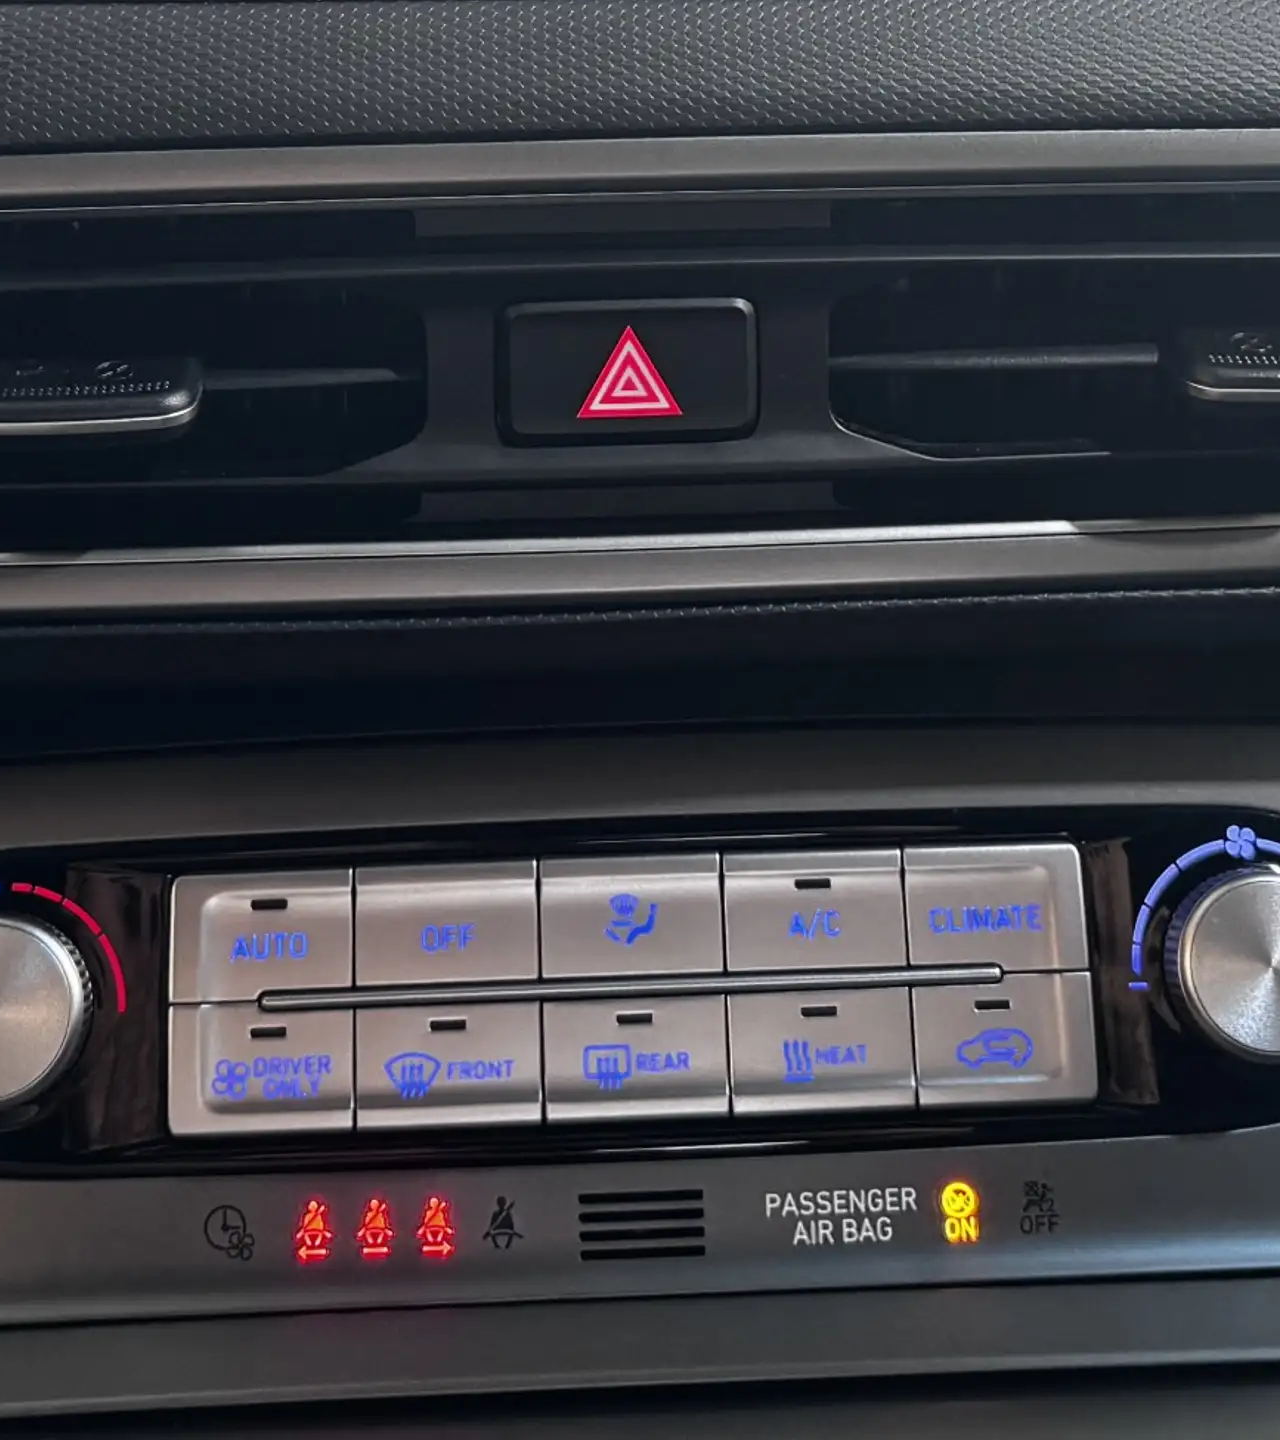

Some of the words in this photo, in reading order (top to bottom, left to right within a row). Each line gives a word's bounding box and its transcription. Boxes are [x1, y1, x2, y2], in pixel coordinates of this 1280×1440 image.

[787, 908, 842, 941] A/C
[928, 903, 1043, 935] CLIMATE
[230, 932, 309, 962] AUTO
[420, 923, 476, 953] OFF
[252, 1054, 332, 1078] DRIVER
[635, 1051, 691, 1074] REAR
[815, 1043, 867, 1067] HEAT
[445, 1059, 516, 1082] FRONT
[765, 1187, 917, 1217] PASSENGER
[793, 1219, 835, 1246] AIR
[842, 1216, 894, 1244] BAG
[943, 1215, 980, 1244] ON
[1020, 1213, 1061, 1236] OFF
